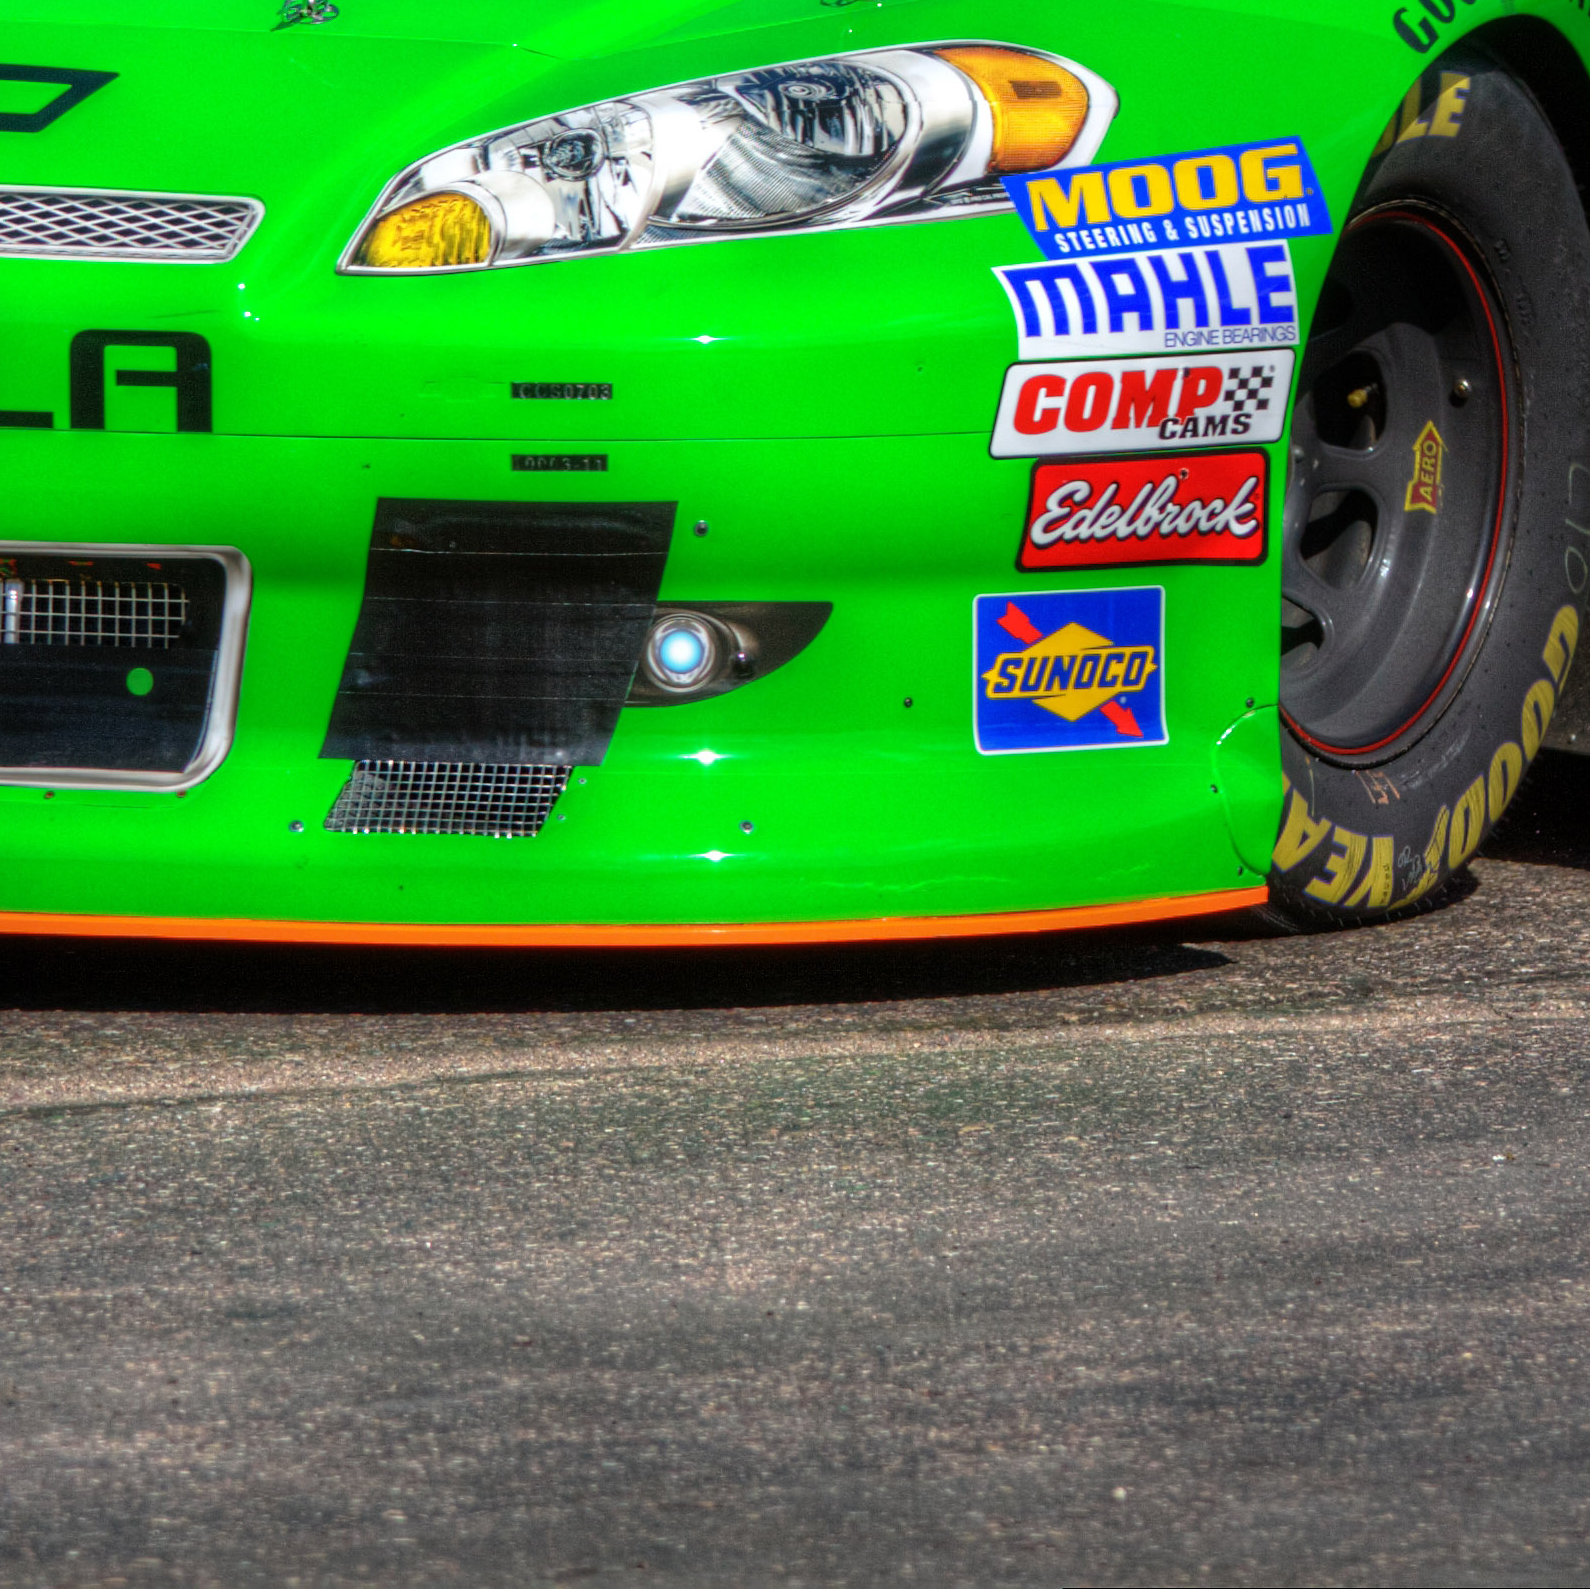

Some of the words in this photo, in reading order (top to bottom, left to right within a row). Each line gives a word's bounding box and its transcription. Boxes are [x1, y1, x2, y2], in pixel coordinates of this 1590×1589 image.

[1026, 142, 1303, 233] MOOG
[1054, 221, 1157, 253] STEERING
[1162, 217, 1179, 242] &
[1184, 202, 1310, 240] SUSPENSION
[1001, 243, 1296, 338] MAHLE
[1164, 329, 1220, 348] ENGINE
[1223, 325, 1296, 346] BEARINGS
[1013, 365, 1224, 436] COMP
[1157, 412, 1252, 441] CAMS
[1420, 440, 1437, 502] AERO
[1030, 474, 1259, 549] Edelbrock
[992, 650, 1150, 694] SUNOCO
